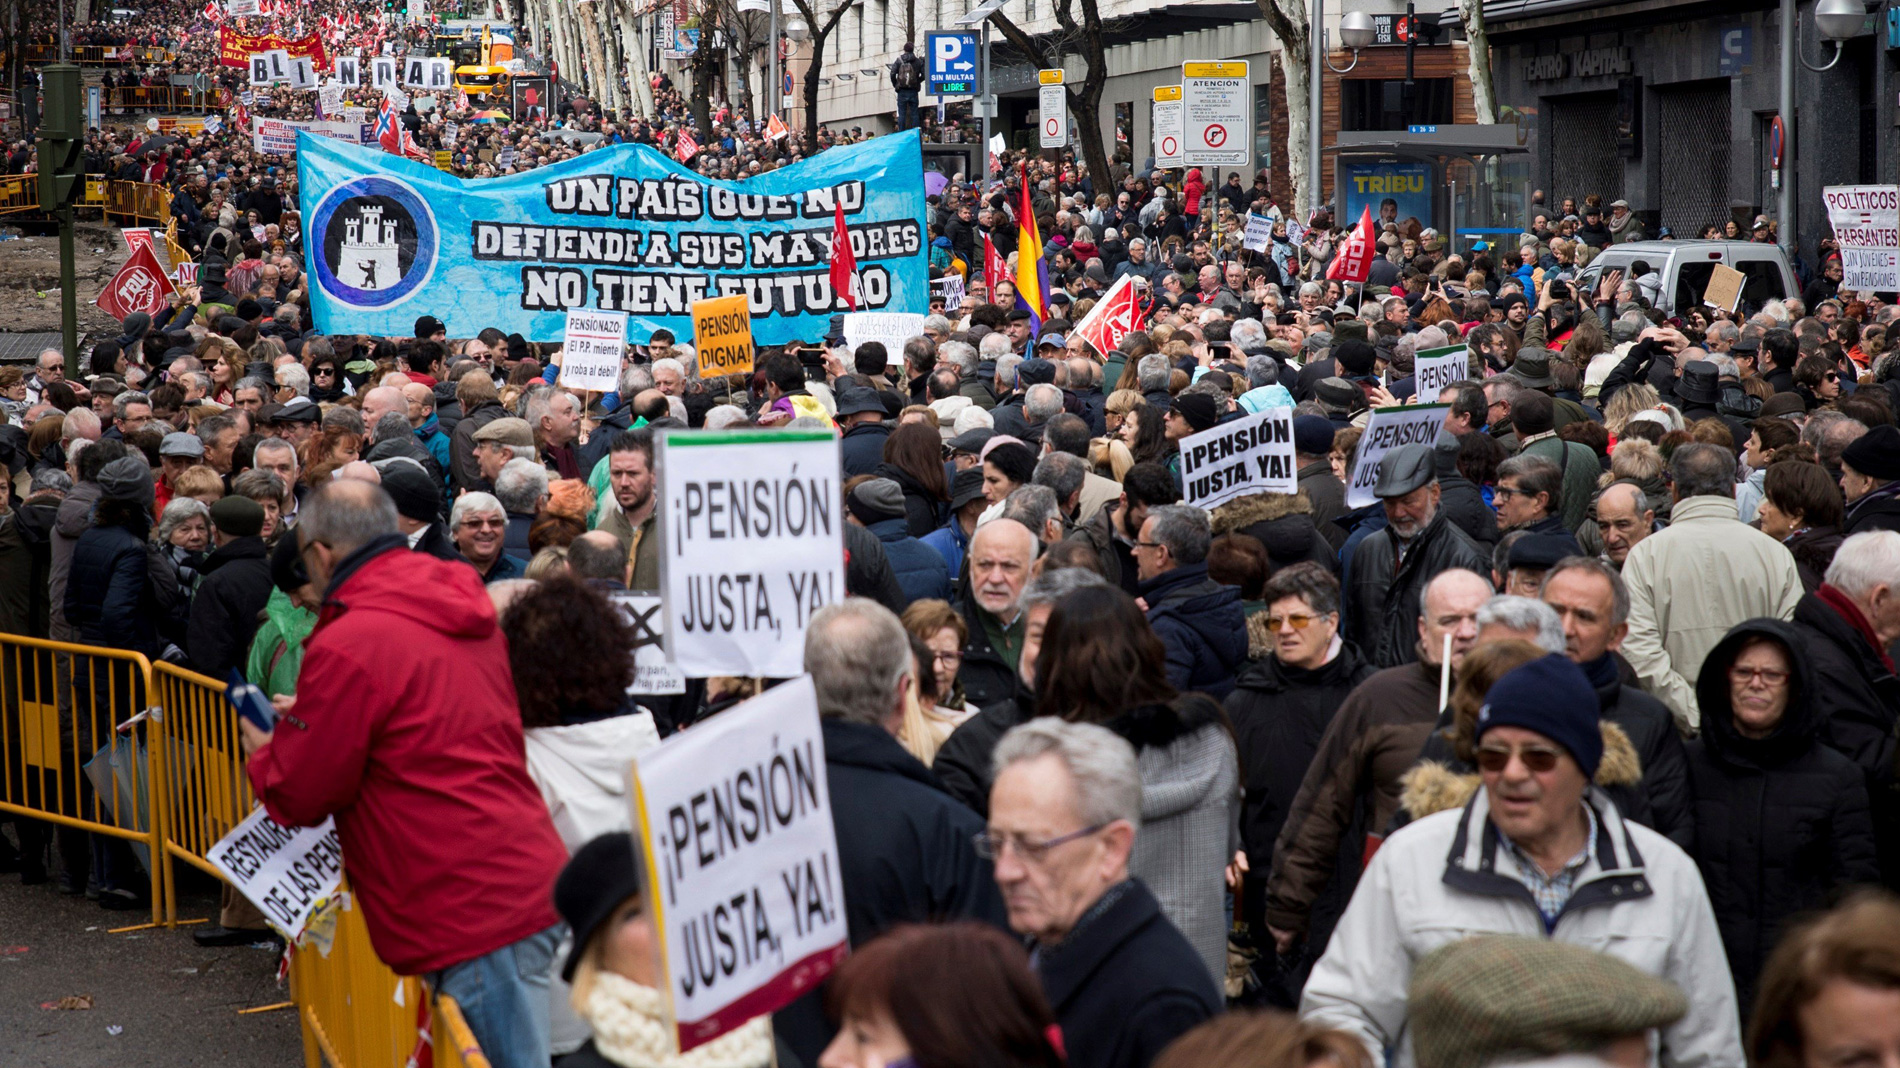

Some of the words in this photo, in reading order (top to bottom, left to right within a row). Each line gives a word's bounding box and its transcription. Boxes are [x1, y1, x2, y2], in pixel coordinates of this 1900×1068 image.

[665, 13, 673, 48] HOSTAL
[1375, 16, 1391, 25] BORN
[1378, 34, 1391, 43] FISH
[935, 37, 961, 72] P
[1522, 55, 1563, 80] TEATRO
[1573, 46, 1629, 76] KAPITAL
[943, 83, 965, 92] LIBRE
[549, 178, 611, 212] UN
[619, 173, 701, 216] PAÍS
[711, 186, 792, 216] QUE
[806, 181, 862, 213] NO
[1828, 188, 1897, 210] POLÍTICOS
[478, 225, 639, 263] DEFIENDE
[645, 234, 672, 264] A
[680, 235, 744, 264] SUS
[1837, 229, 1898, 247] FARSANTES
[526, 270, 582, 307] NO
[595, 273, 706, 313] TIENE
[698, 308, 749, 344] ¡PENSIÓN
[567, 343, 577, 355] ¡El
[579, 343, 591, 354] P.P.
[593, 344, 619, 356] miente
[701, 346, 751, 370] DIGNA!
[565, 367, 570, 377] y
[571, 365, 588, 377] roba
[590, 366, 597, 377] al
[1418, 357, 1466, 397] ¡PENSIÓN
[1184, 417, 1290, 475] ¡PENSIÓN
[1364, 415, 1441, 457] ¡PENSIÓN
[1189, 461, 1253, 504] JUSTA,
[1257, 455, 1291, 479] YA!
[674, 461, 832, 557] ¡PENSIÓN
[682, 573, 782, 641] JUSTA,
[648, 665, 670, 679] pan,
[656, 679, 680, 690] paz.
[660, 734, 819, 906] ¡PENSIÓN
[278, 861, 322, 907] LAS
[262, 886, 302, 926] DE
[680, 887, 785, 999] JUSTA,
[781, 852, 836, 938] YA!
